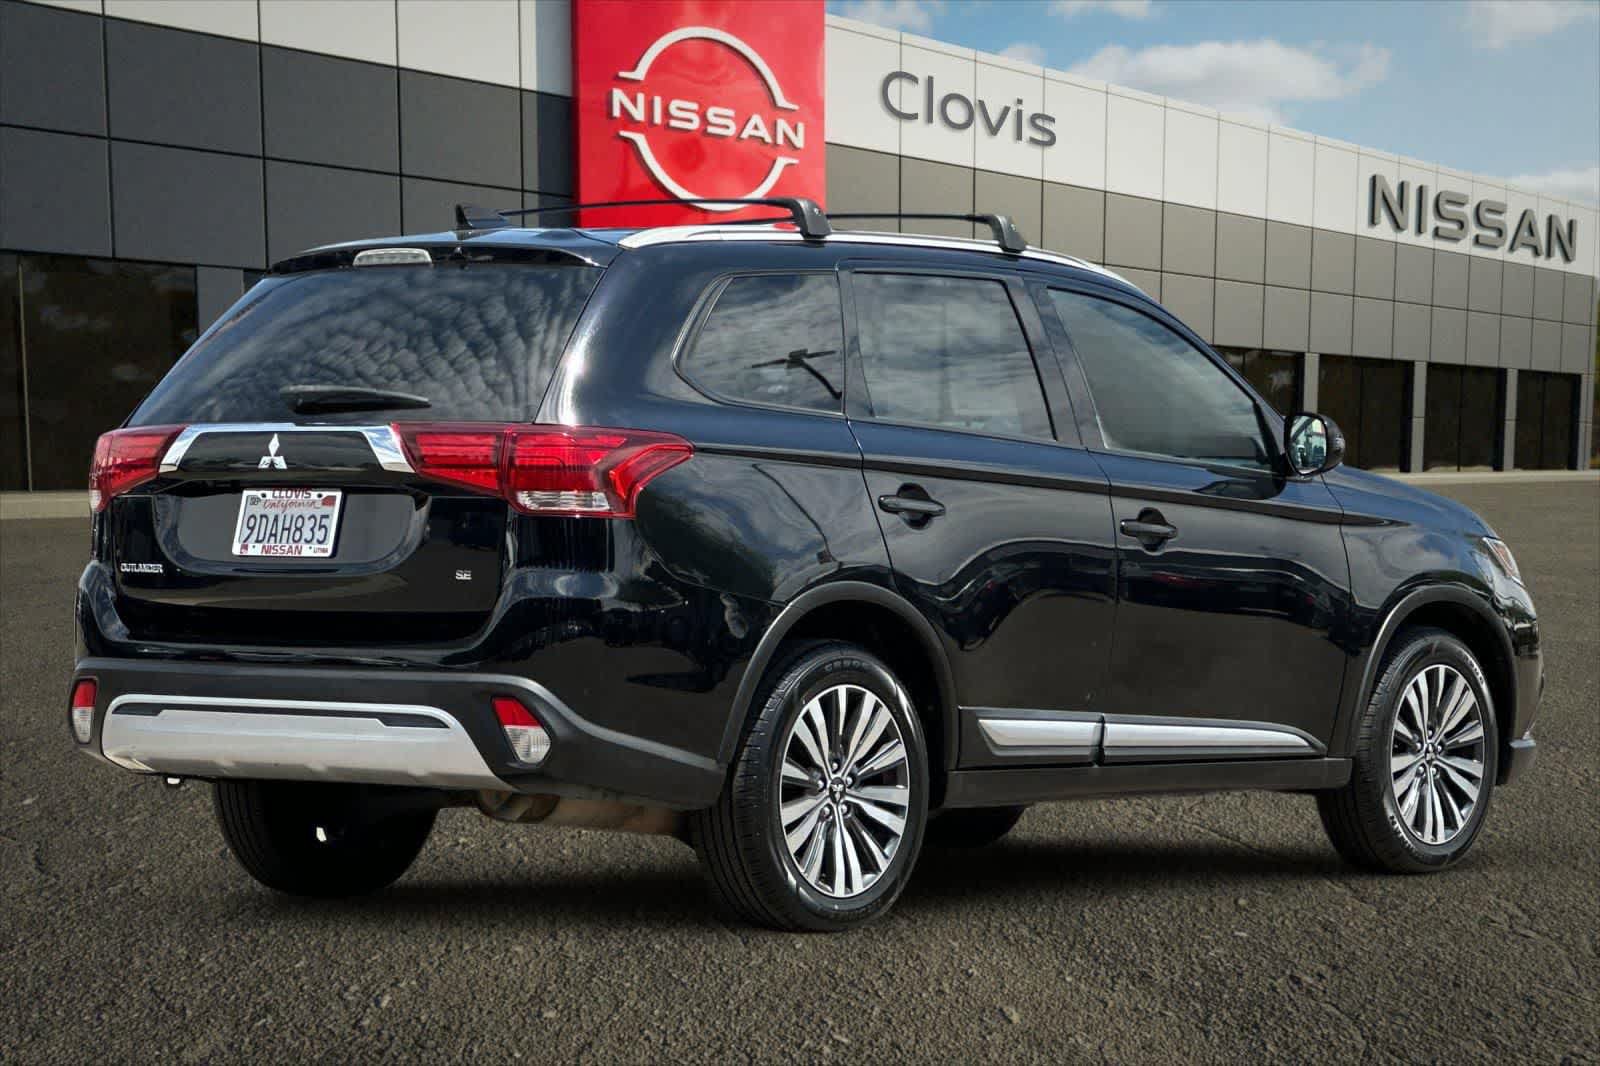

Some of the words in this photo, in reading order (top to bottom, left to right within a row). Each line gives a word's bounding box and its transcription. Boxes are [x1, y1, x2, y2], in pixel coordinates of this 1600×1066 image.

[611, 87, 805, 148] NISSAN
[881, 71, 1057, 147] Clovis
[1368, 173, 1577, 264] NISSAN
[271, 488, 312, 499] CLOVIS
[242, 514, 330, 544] 9DAH835
[261, 545, 303, 555] NISSAN
[455, 569, 472, 580] SE
